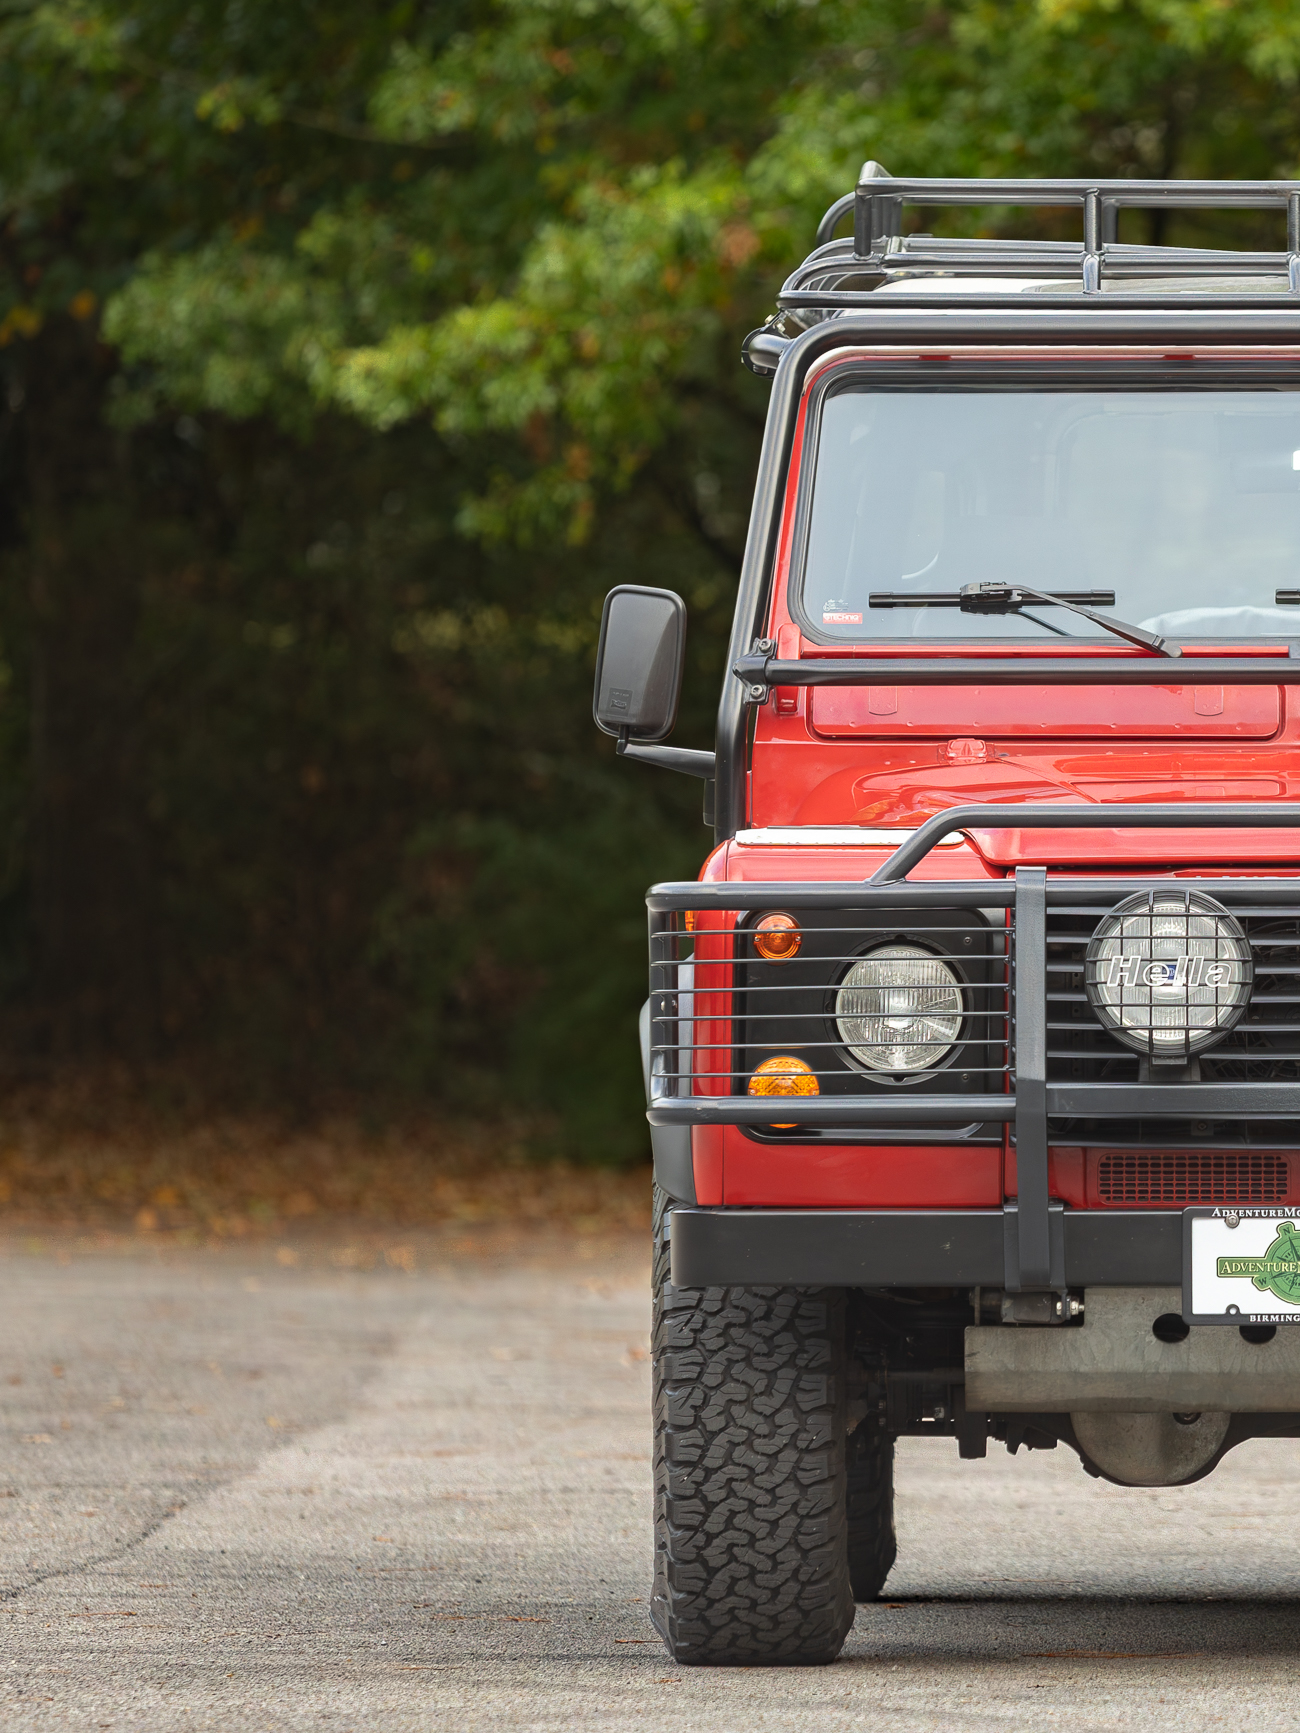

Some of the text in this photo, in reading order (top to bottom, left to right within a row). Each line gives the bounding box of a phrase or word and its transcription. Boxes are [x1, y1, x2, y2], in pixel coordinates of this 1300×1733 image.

[1108, 956, 1231, 987] Hella
[1283, 1226, 1291, 1236] N
[1258, 1277, 1268, 1286] W
